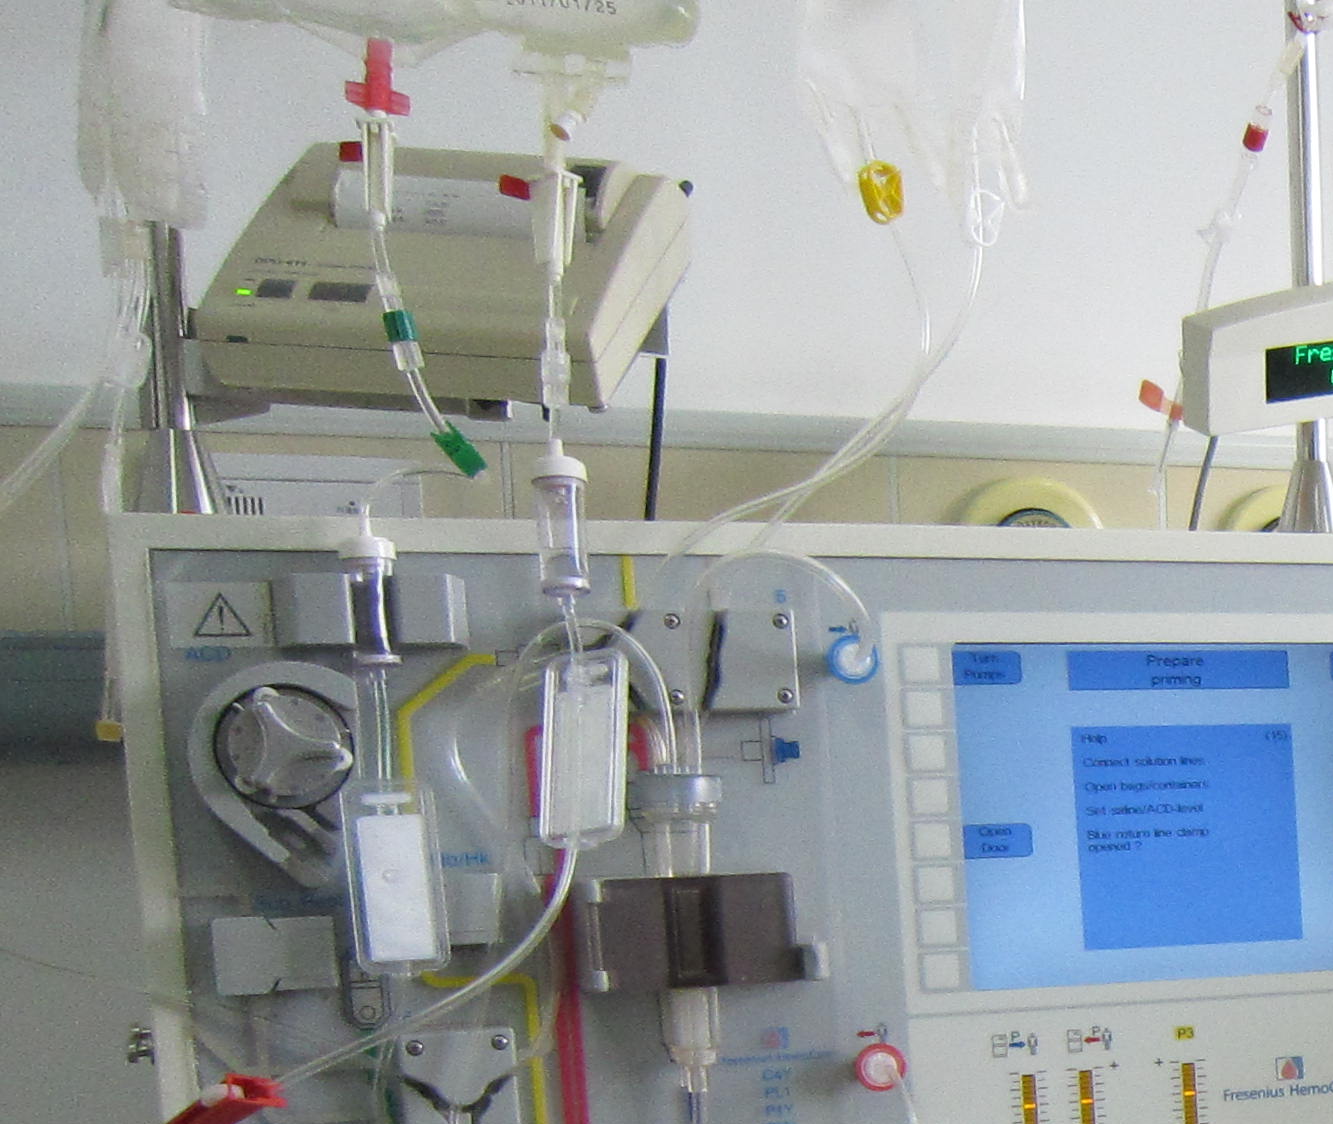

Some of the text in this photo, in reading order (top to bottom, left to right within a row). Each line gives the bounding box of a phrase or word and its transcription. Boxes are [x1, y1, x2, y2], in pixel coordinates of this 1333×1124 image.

[1146, 654, 1204, 668] Prepare
[1151, 673, 1202, 687] priming
[1081, 733, 1107, 745] Help
[1082, 757, 1129, 768] Connect
[1134, 756, 1177, 767] solution
[1085, 781, 1117, 793] Open
[1177, 1026, 1195, 1039] P3
[1223, 1085, 1285, 1101] Fresenius
